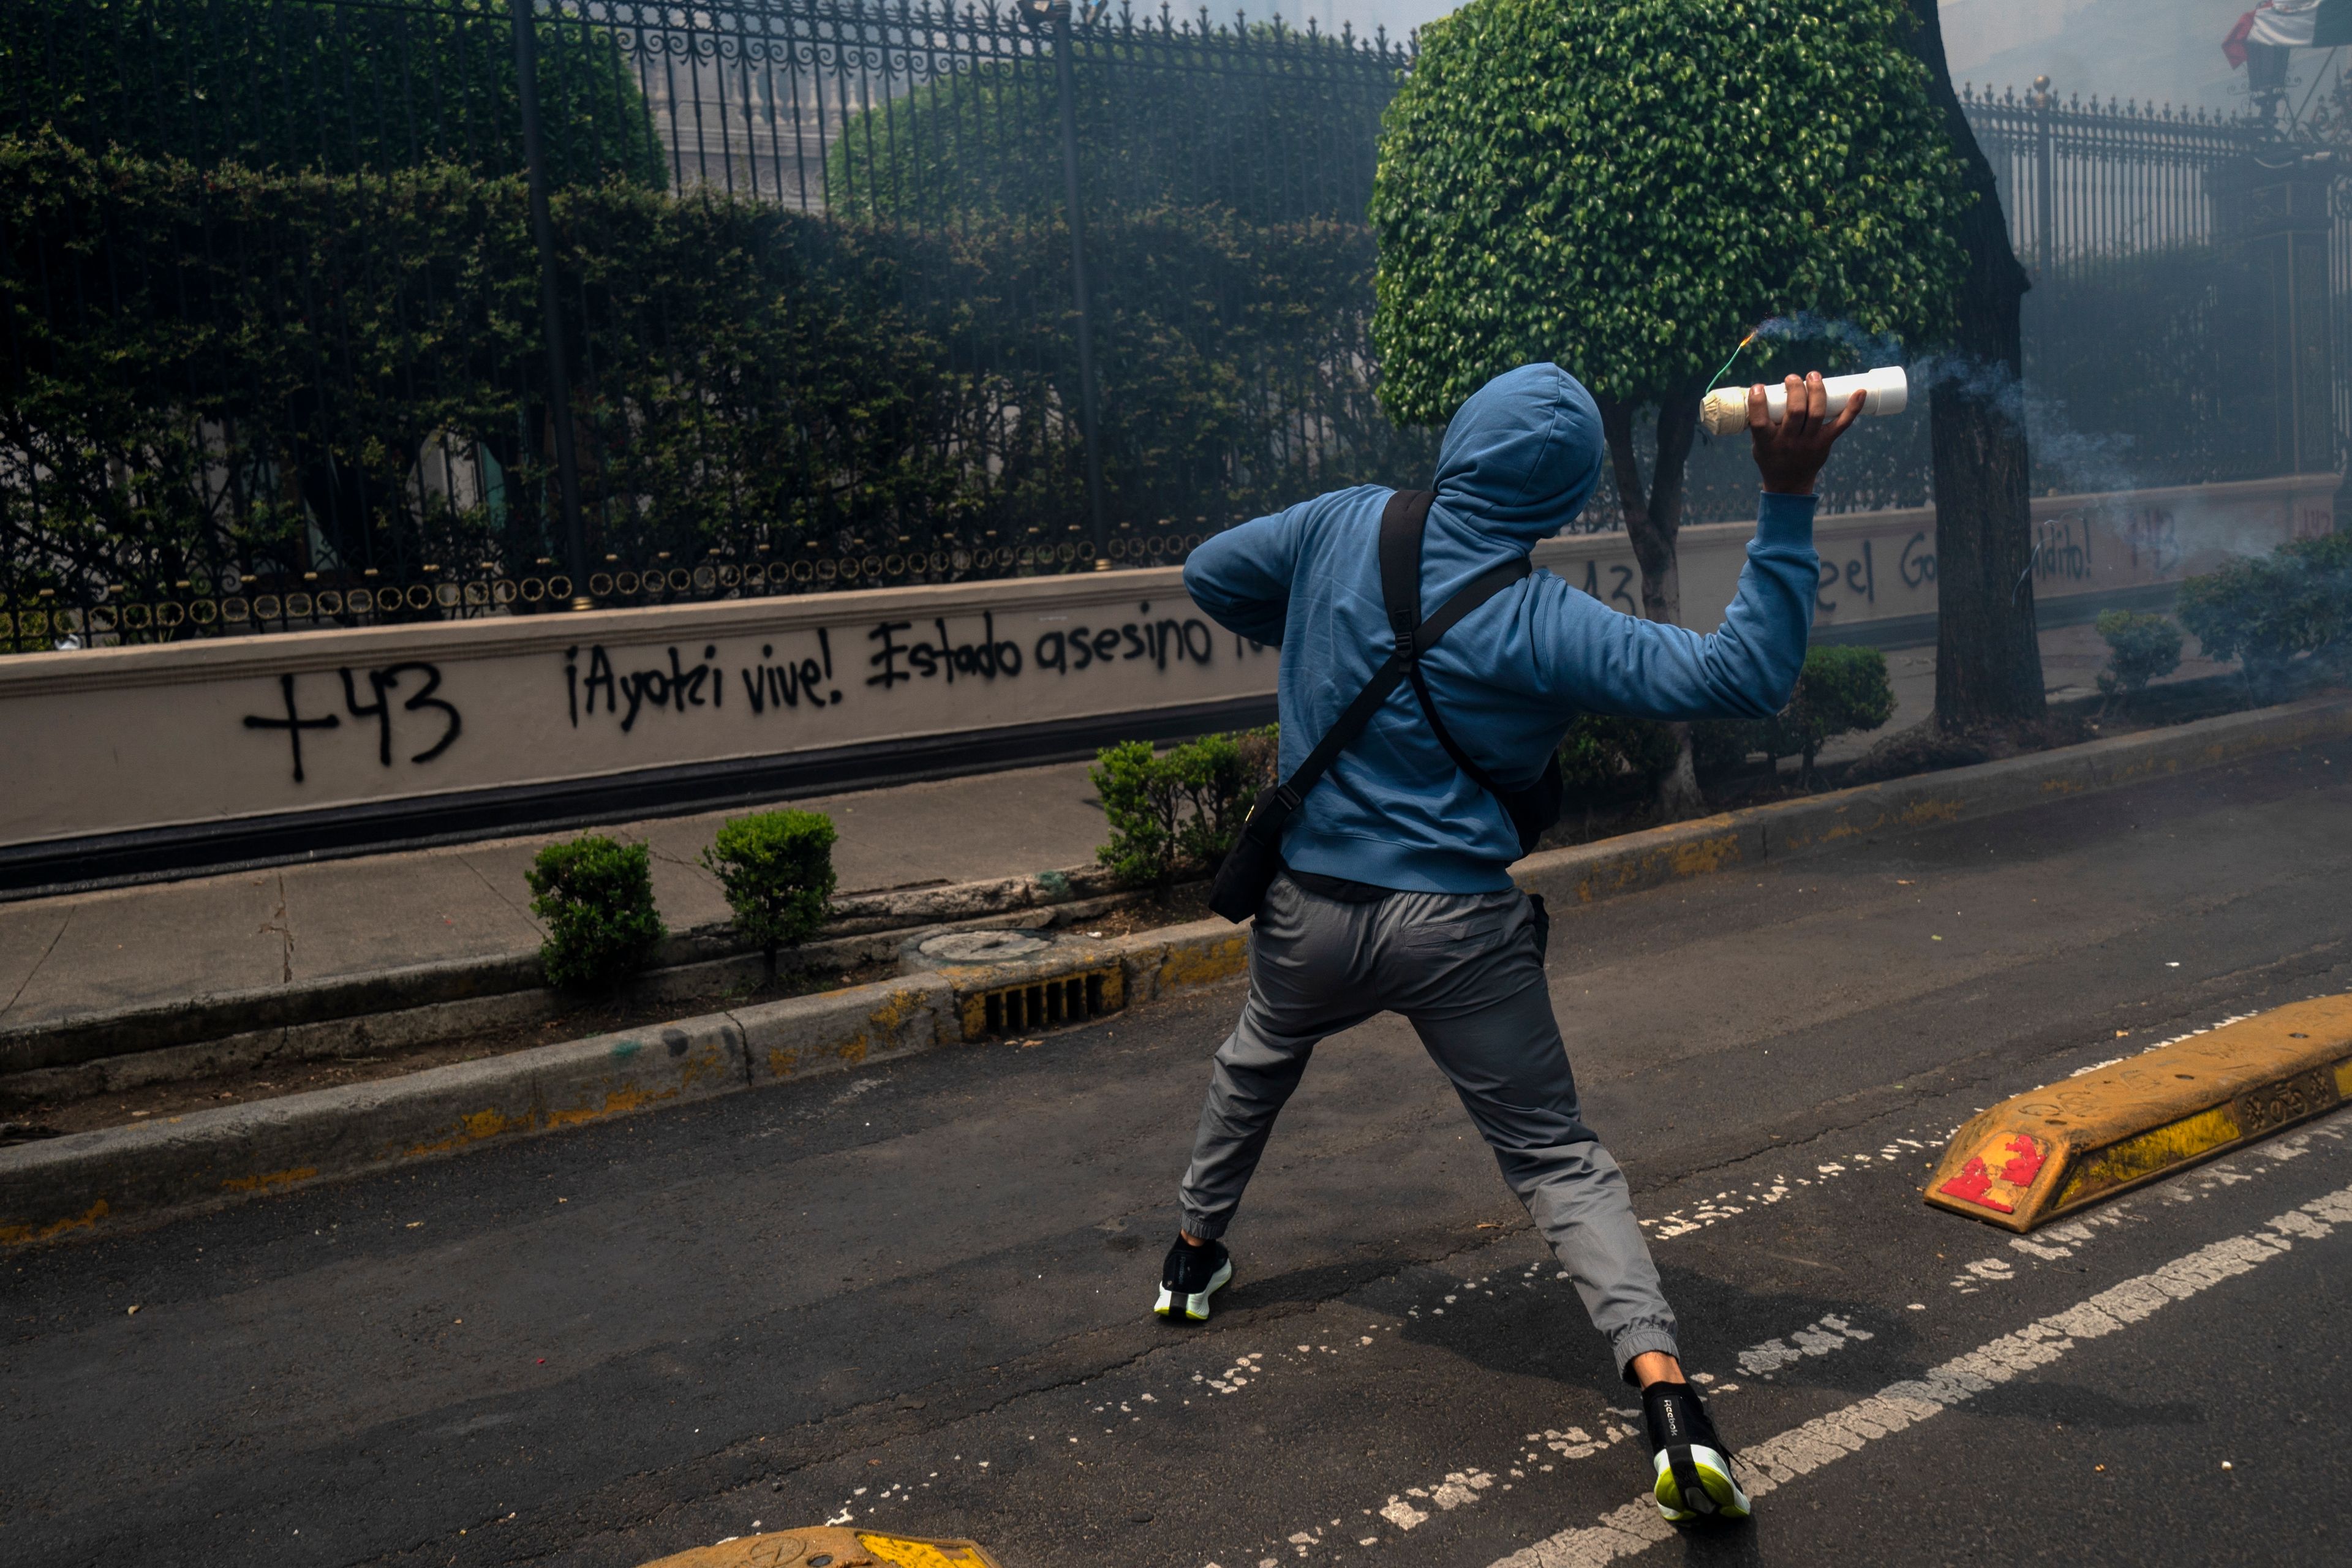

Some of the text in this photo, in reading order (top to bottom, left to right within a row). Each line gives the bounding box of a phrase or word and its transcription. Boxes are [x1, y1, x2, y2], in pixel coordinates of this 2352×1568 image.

[1845, 538, 1875, 604] el
[2031, 517, 2092, 580] ldito!
[742, 627, 843, 715] vive!
[865, 610, 1022, 689] Estado
[1035, 601, 1212, 674] asesino
[1664, 1399, 1678, 1437] Reebok
